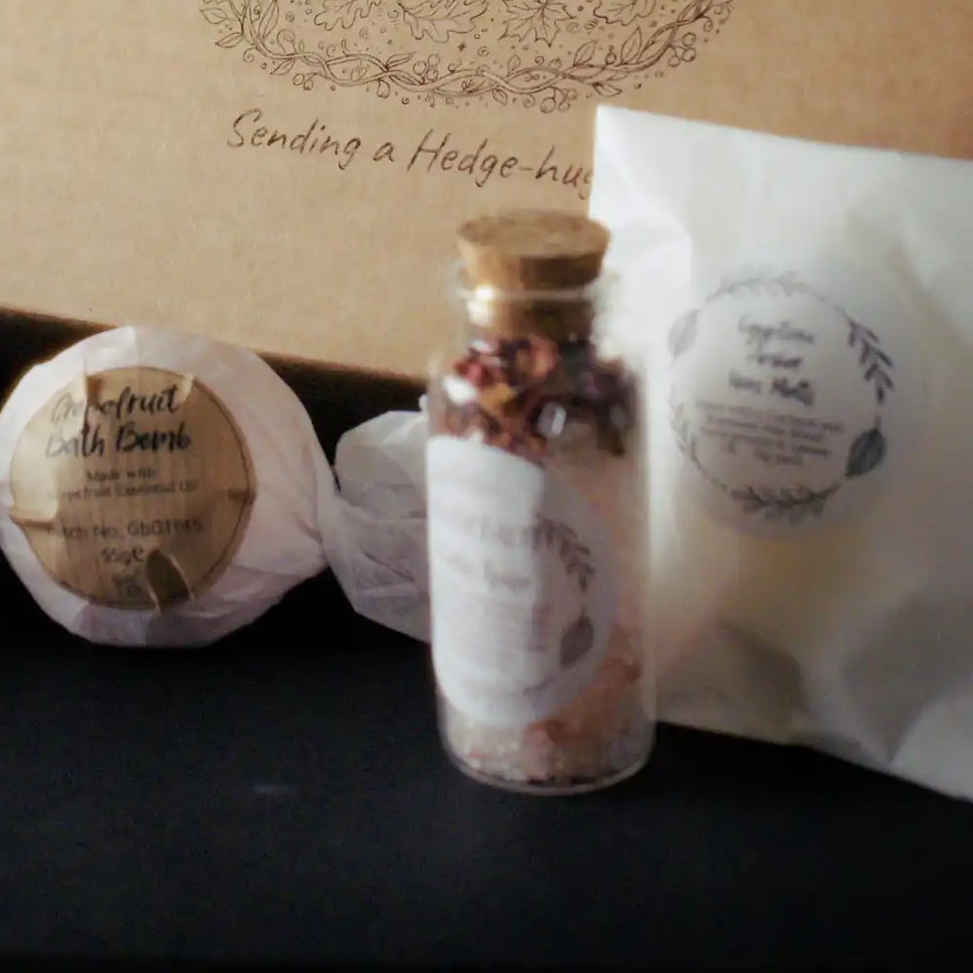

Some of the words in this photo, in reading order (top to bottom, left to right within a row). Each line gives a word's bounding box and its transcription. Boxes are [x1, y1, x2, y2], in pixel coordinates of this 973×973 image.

[227, 109, 362, 170] Sending
[372, 145, 395, 163] a
[114, 421, 193, 453] Bomb
